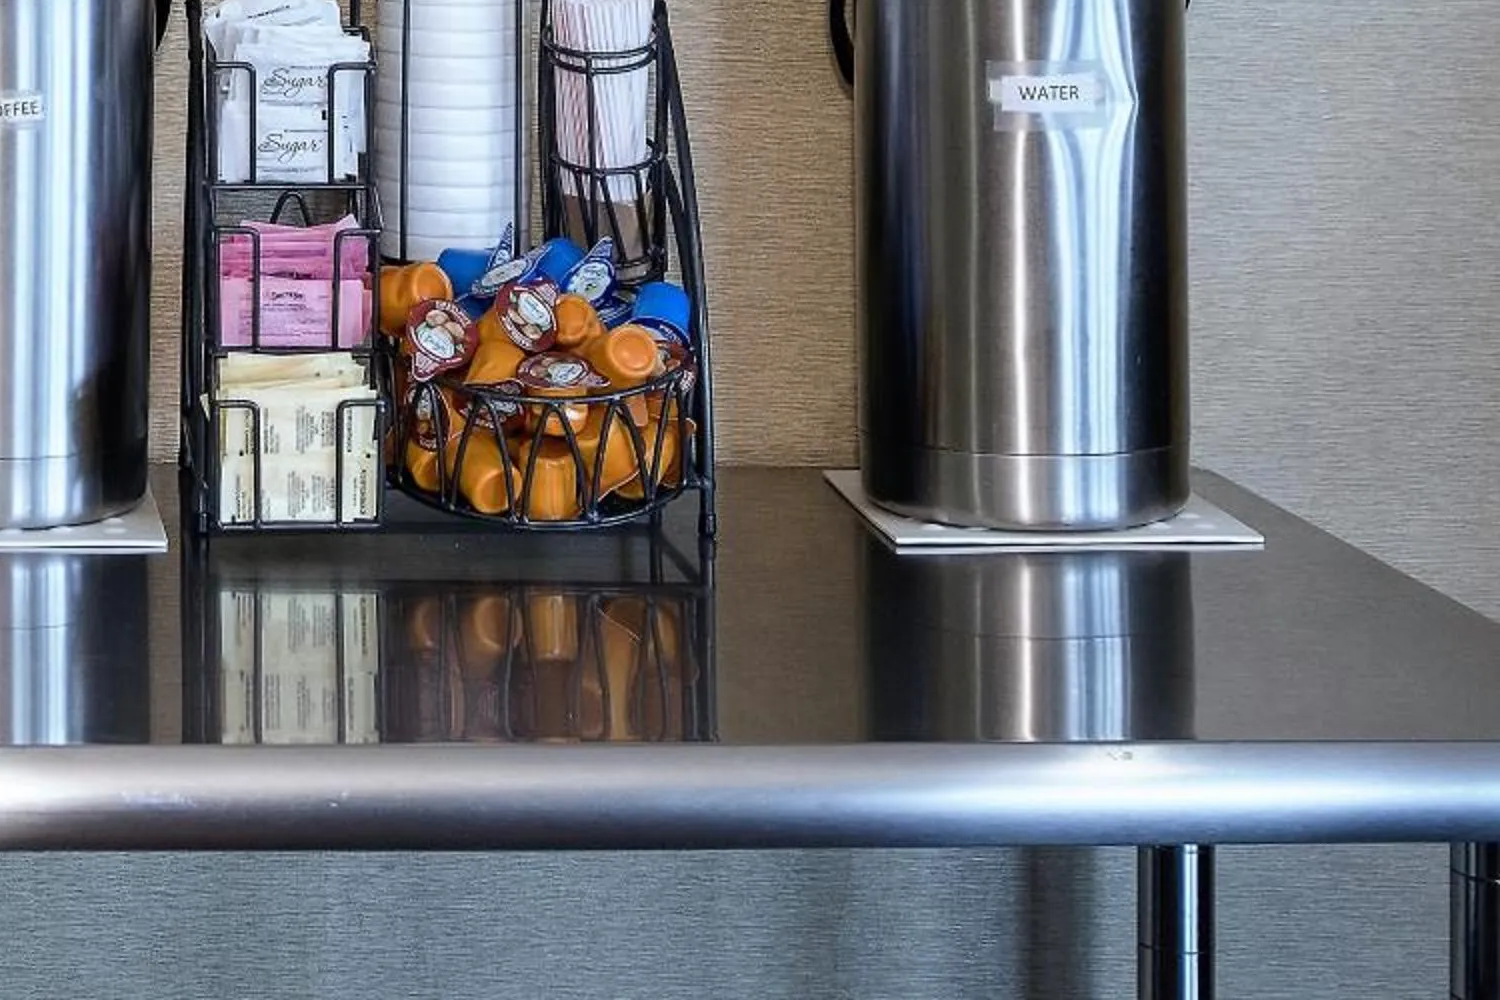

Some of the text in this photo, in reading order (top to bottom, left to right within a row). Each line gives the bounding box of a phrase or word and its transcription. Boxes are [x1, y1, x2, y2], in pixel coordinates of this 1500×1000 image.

[263, 67, 326, 98] Sugar
[1018, 85, 1080, 101] WATER
[257, 132, 323, 164] Sugar
